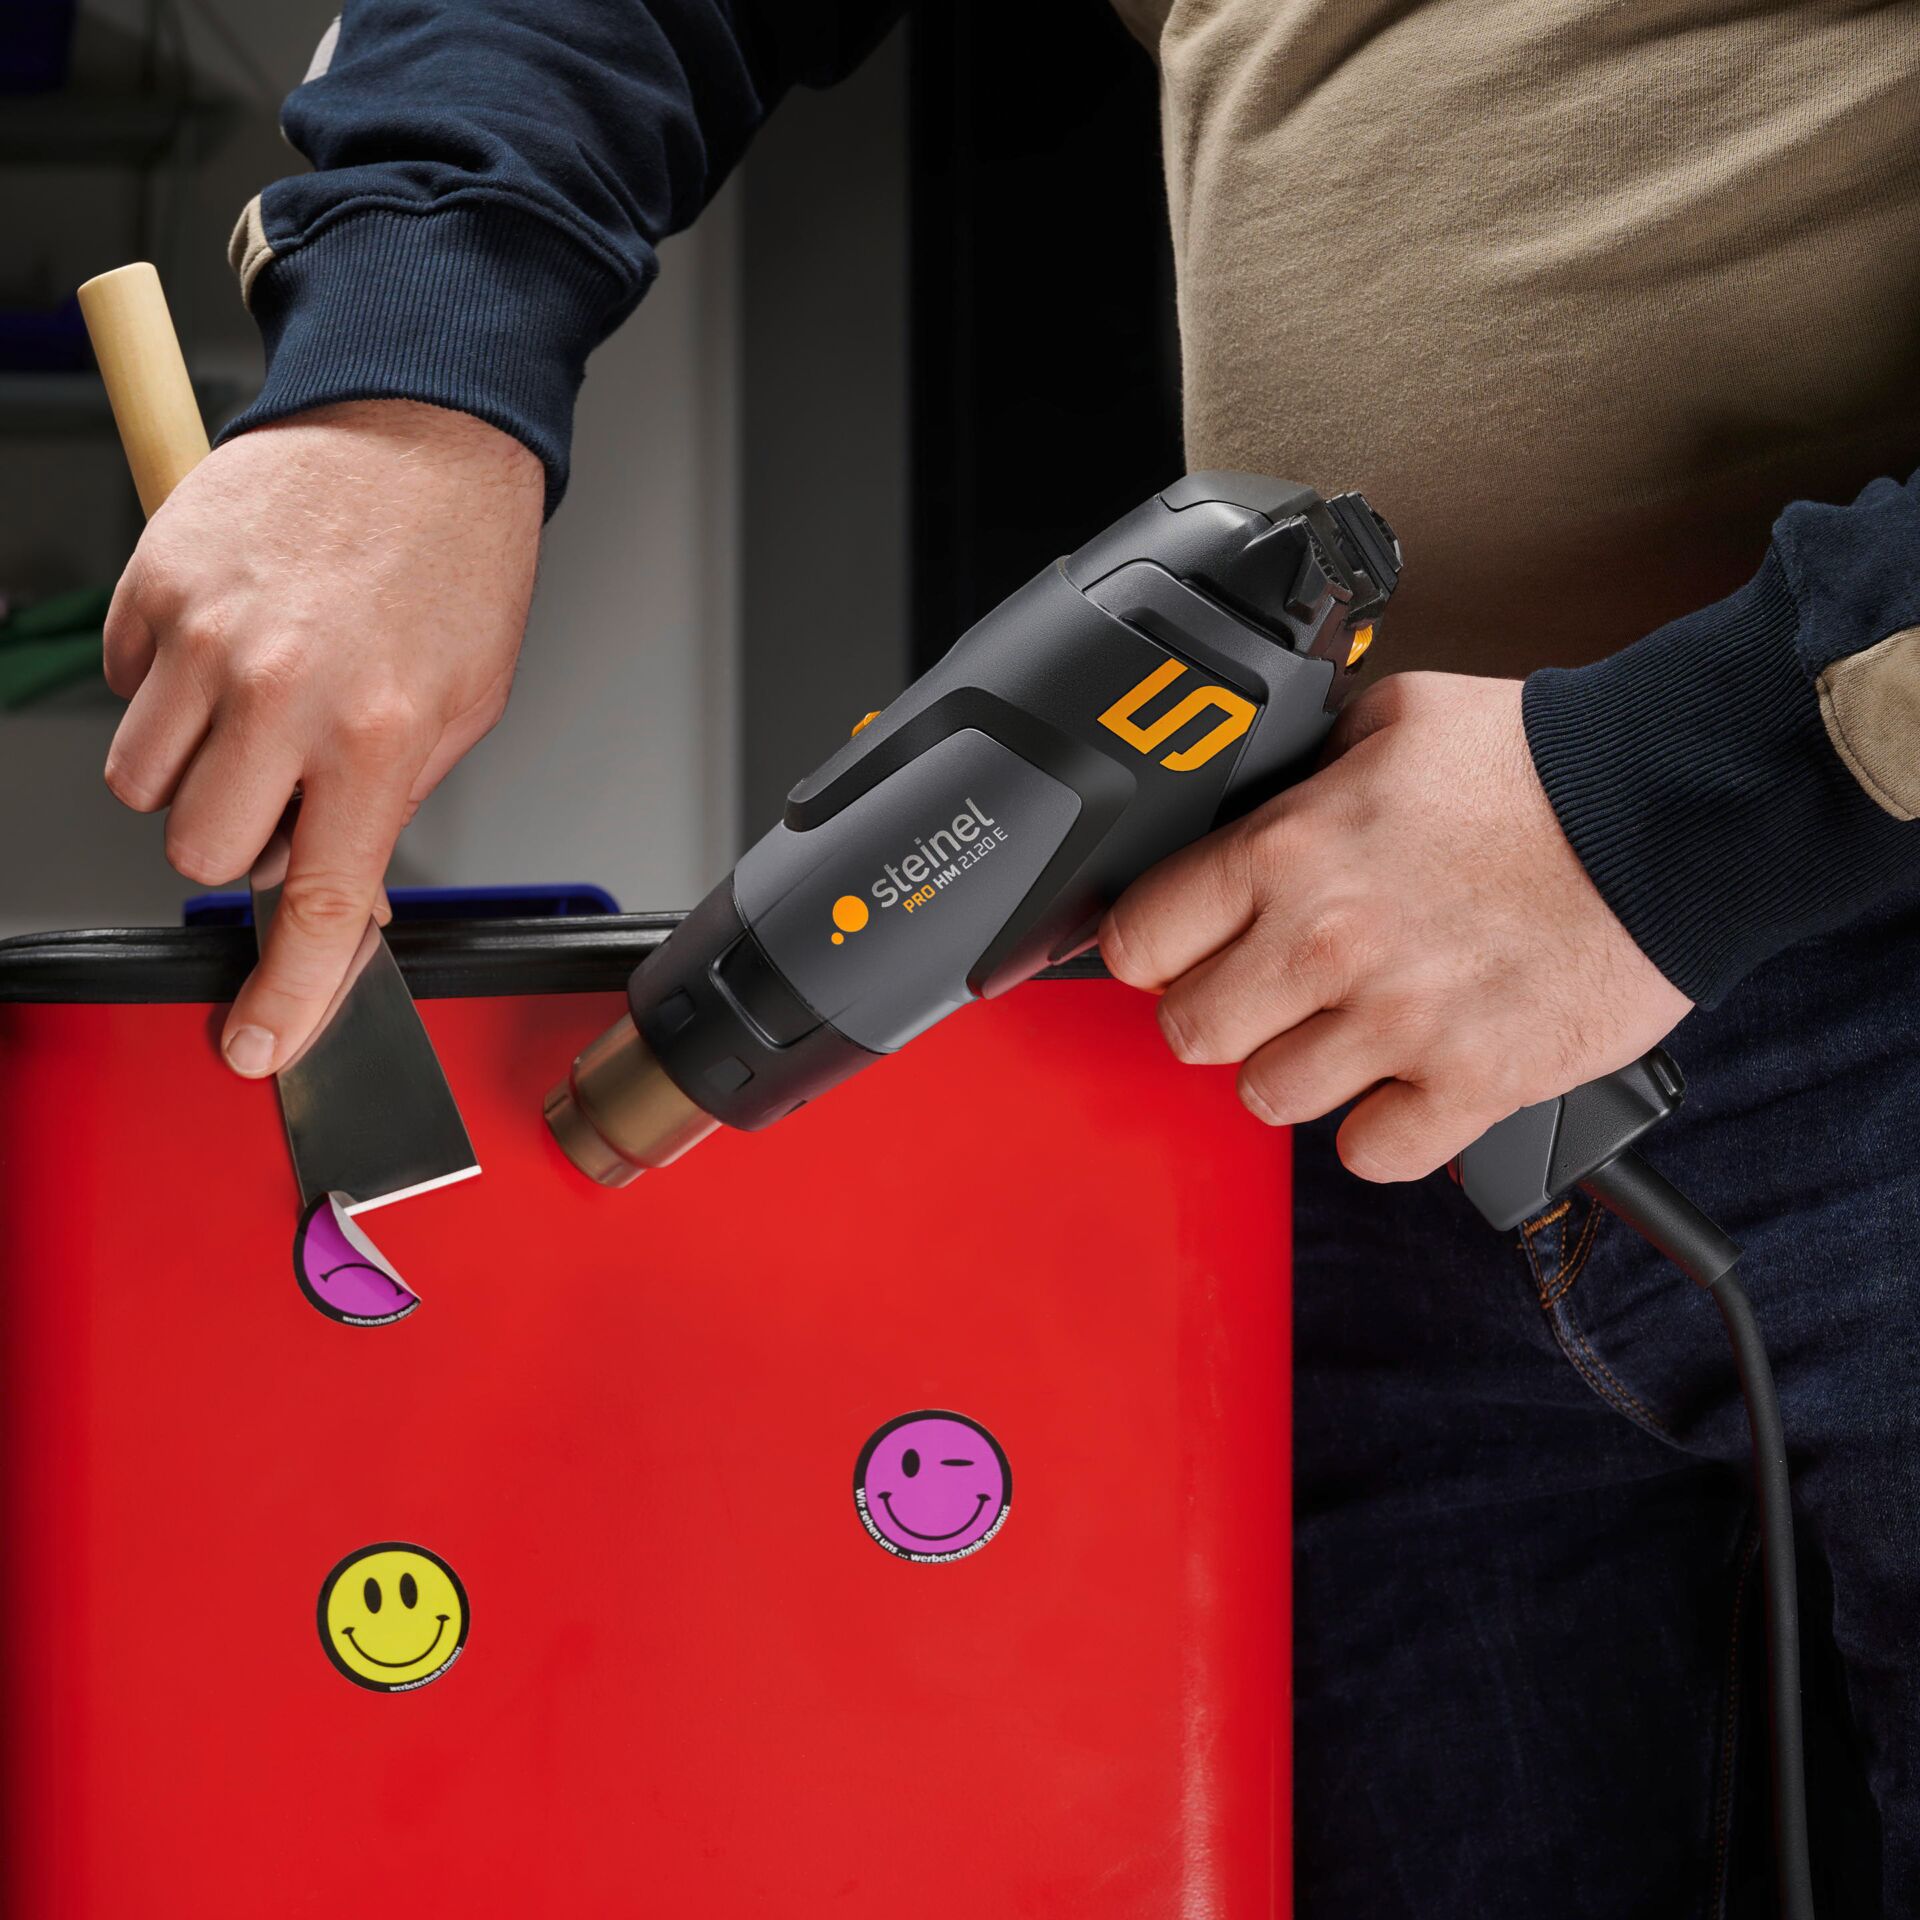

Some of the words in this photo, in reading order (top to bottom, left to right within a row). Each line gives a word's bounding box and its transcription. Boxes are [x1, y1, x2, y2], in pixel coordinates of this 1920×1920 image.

[871, 797, 995, 908] steinel
[902, 884, 936, 913] PRO
[933, 863, 961, 889] HM
[957, 836, 996, 870] 2120
[992, 826, 1008, 841] E
[855, 1487, 867, 1508] Wir
[859, 1509, 882, 1540] sehen
[879, 1538, 899, 1554] uns
